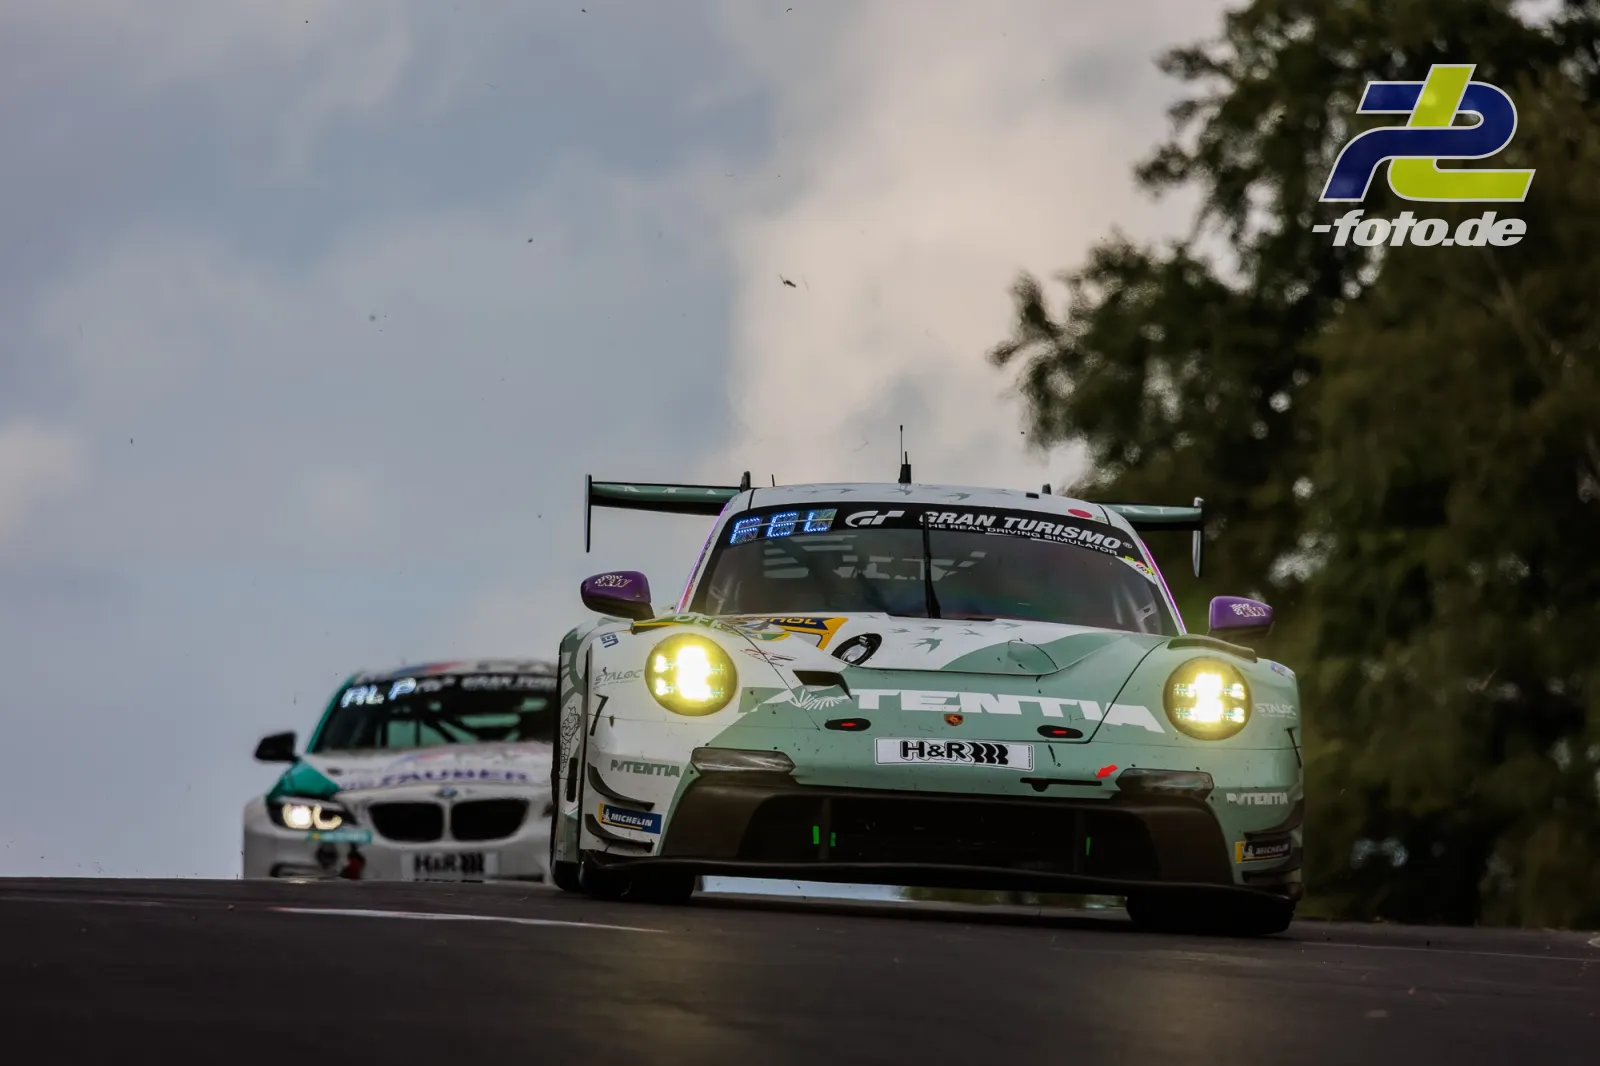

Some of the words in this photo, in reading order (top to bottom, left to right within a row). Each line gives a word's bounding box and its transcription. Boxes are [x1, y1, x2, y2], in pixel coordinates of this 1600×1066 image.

[918, 510, 997, 527] GRAN
[949, 523, 985, 532] REAL
[986, 526, 1041, 539] DRIVING
[1043, 533, 1119, 556] SIMULATOR
[610, 812, 654, 827] MICHELIN
